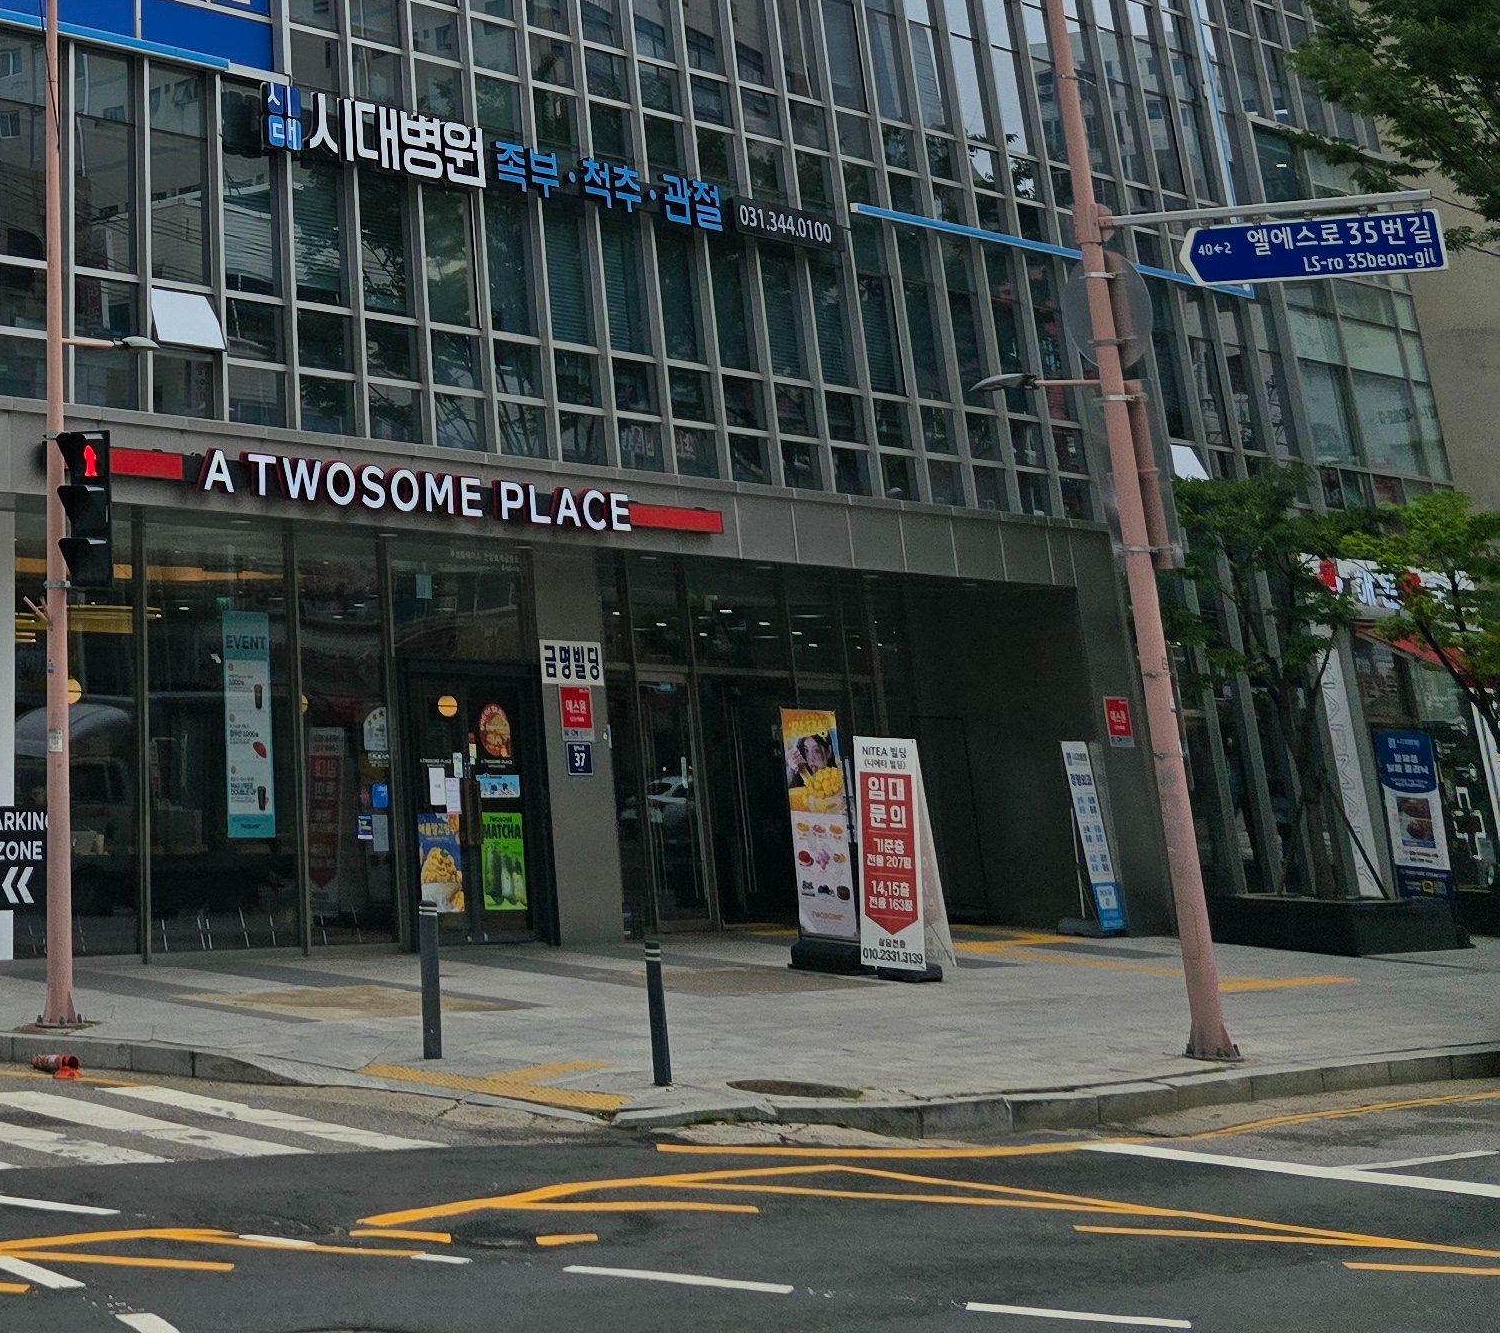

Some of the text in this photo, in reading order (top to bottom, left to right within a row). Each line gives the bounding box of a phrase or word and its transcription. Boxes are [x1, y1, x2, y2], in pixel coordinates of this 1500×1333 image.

[309, 91, 487, 188] 시대병원
[738, 204, 833, 244] 031.344.0100
[1303, 249, 1437, 273] LS-ro 35beon-gil
[203, 449, 633, 532] A TWOSOME PLACE
[225, 635, 267, 650] EVENT
[543, 645, 601, 680] 금명빌딩
[574, 752, 587, 767] 37
[861, 746, 908, 759] NITEA 빌딩
[867, 776, 905, 801] 임대
[869, 803, 907, 828] 문의
[483, 823, 523, 840] MATCHA
[873, 837, 905, 855] 기준층
[866, 853, 912, 869] 전용 207평
[871, 880, 910, 898] 14,15층
[868, 895, 887, 909] 전용
[878, 938, 906, 949] 상담전화
[862, 948, 924, 964] 010.2331.3139
